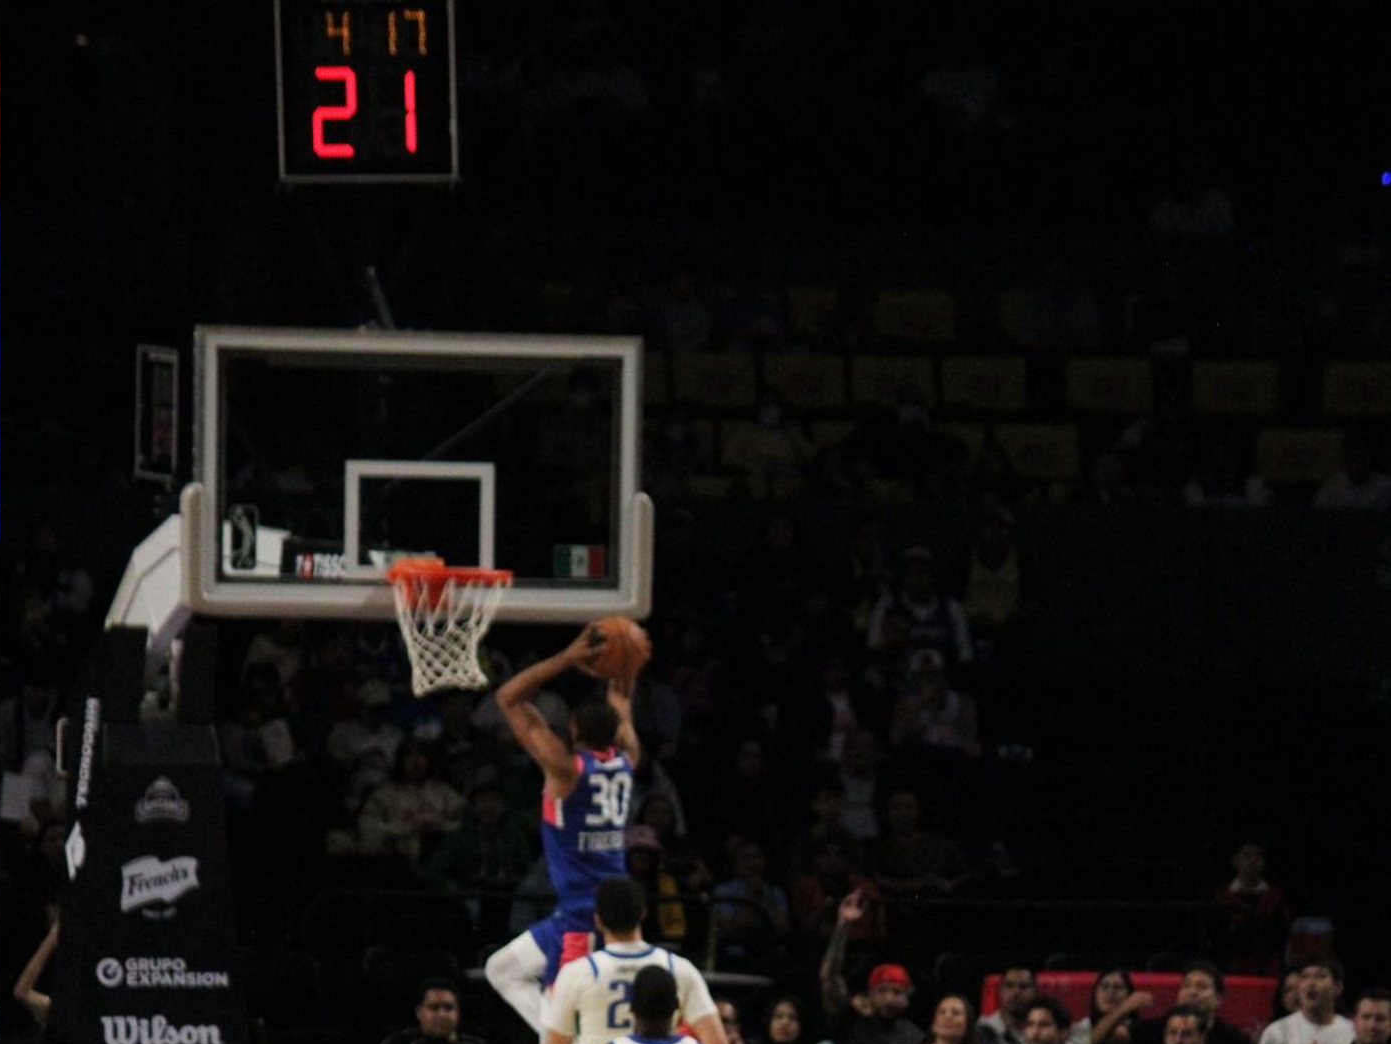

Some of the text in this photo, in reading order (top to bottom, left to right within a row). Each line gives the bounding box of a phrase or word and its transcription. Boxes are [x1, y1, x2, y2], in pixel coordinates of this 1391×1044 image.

[326, 9, 427, 55] 4 17
[312, 66, 417, 158] 21
[585, 773, 633, 827] 30
[125, 957, 186, 972] GRUPO
